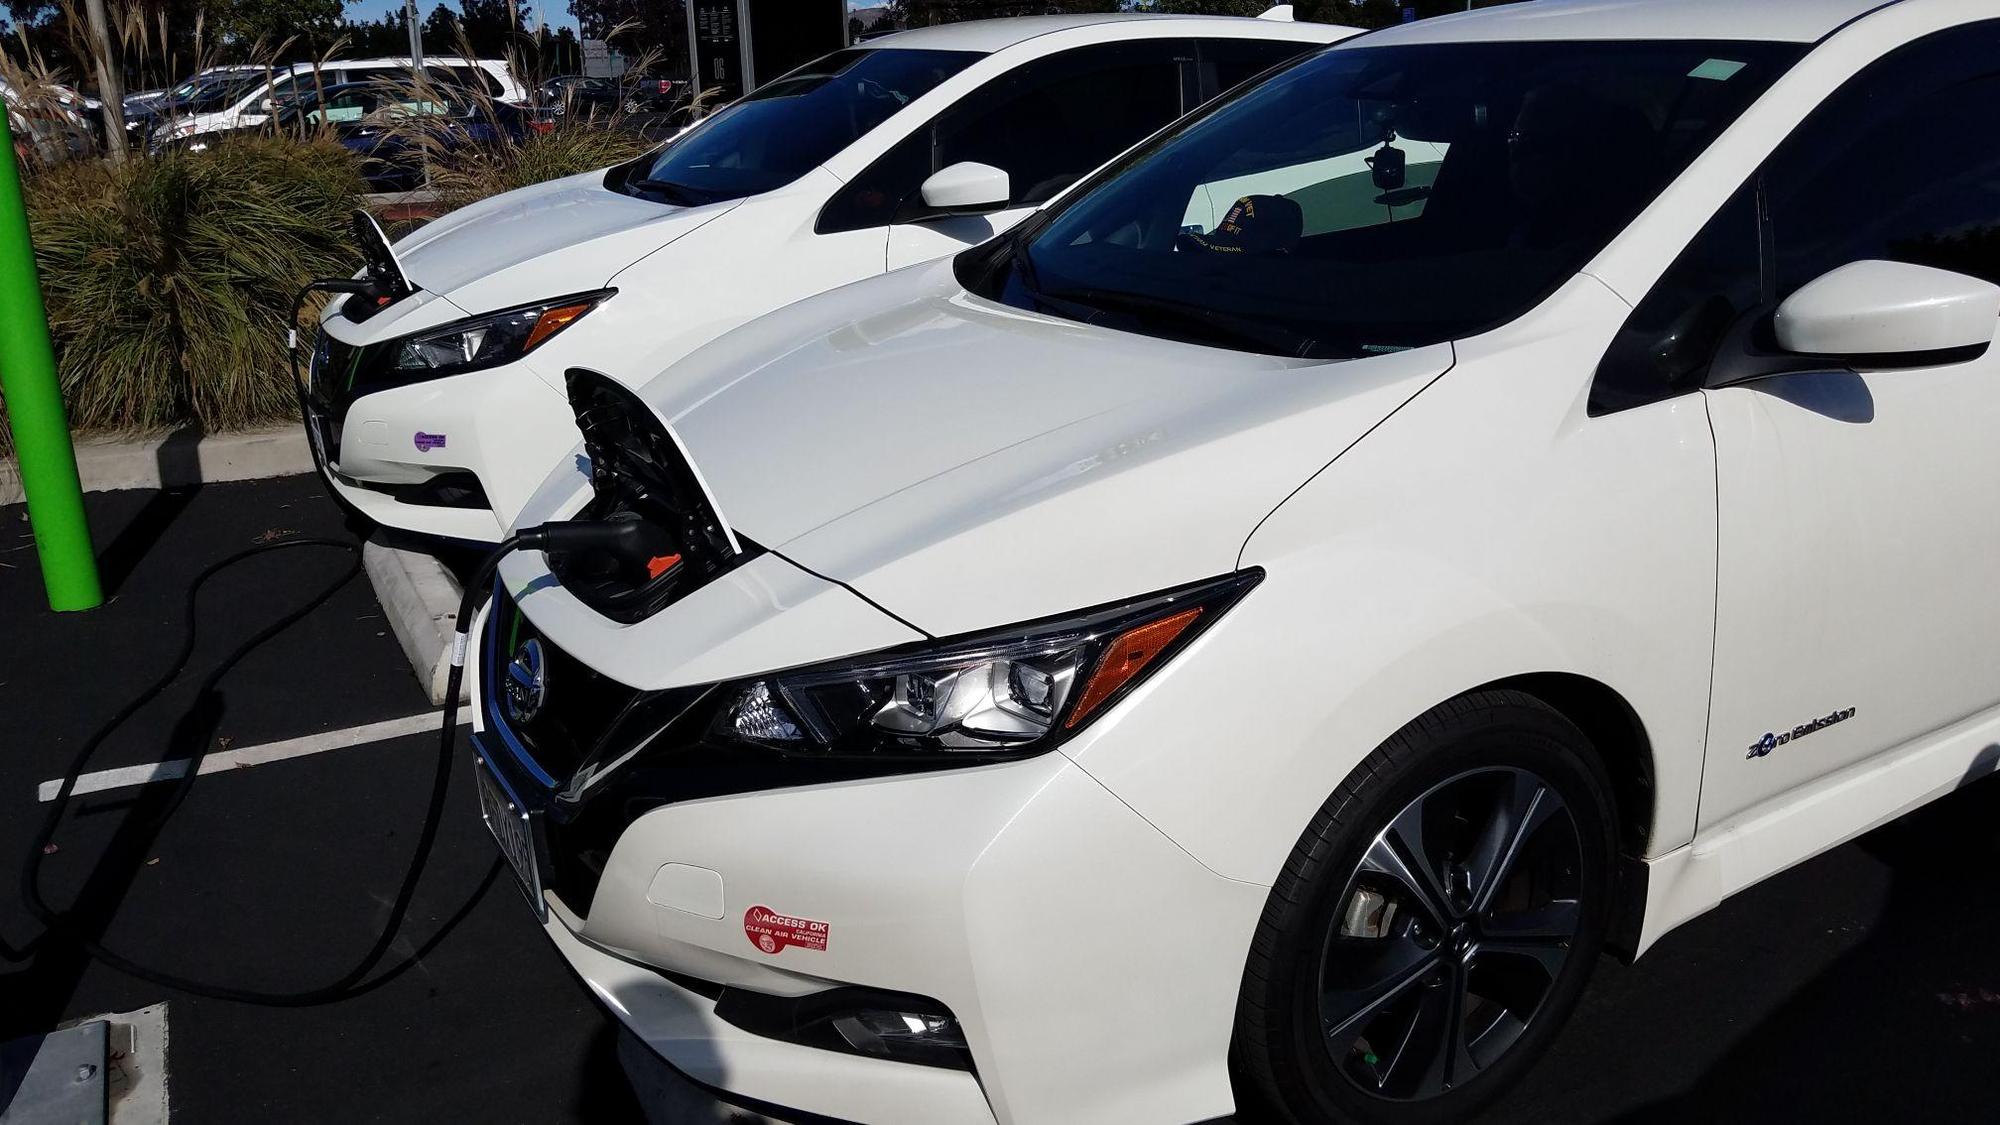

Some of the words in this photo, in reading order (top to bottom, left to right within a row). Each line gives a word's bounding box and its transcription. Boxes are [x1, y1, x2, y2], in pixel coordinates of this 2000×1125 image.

[1791, 706, 1856, 740] Emission
[761, 914, 806, 929] ACCESS
[810, 922, 828, 932] OK
[745, 924, 772, 935] CLEAN
[774, 930, 788, 938] AIR
[791, 933, 826, 944] VEHICLE
